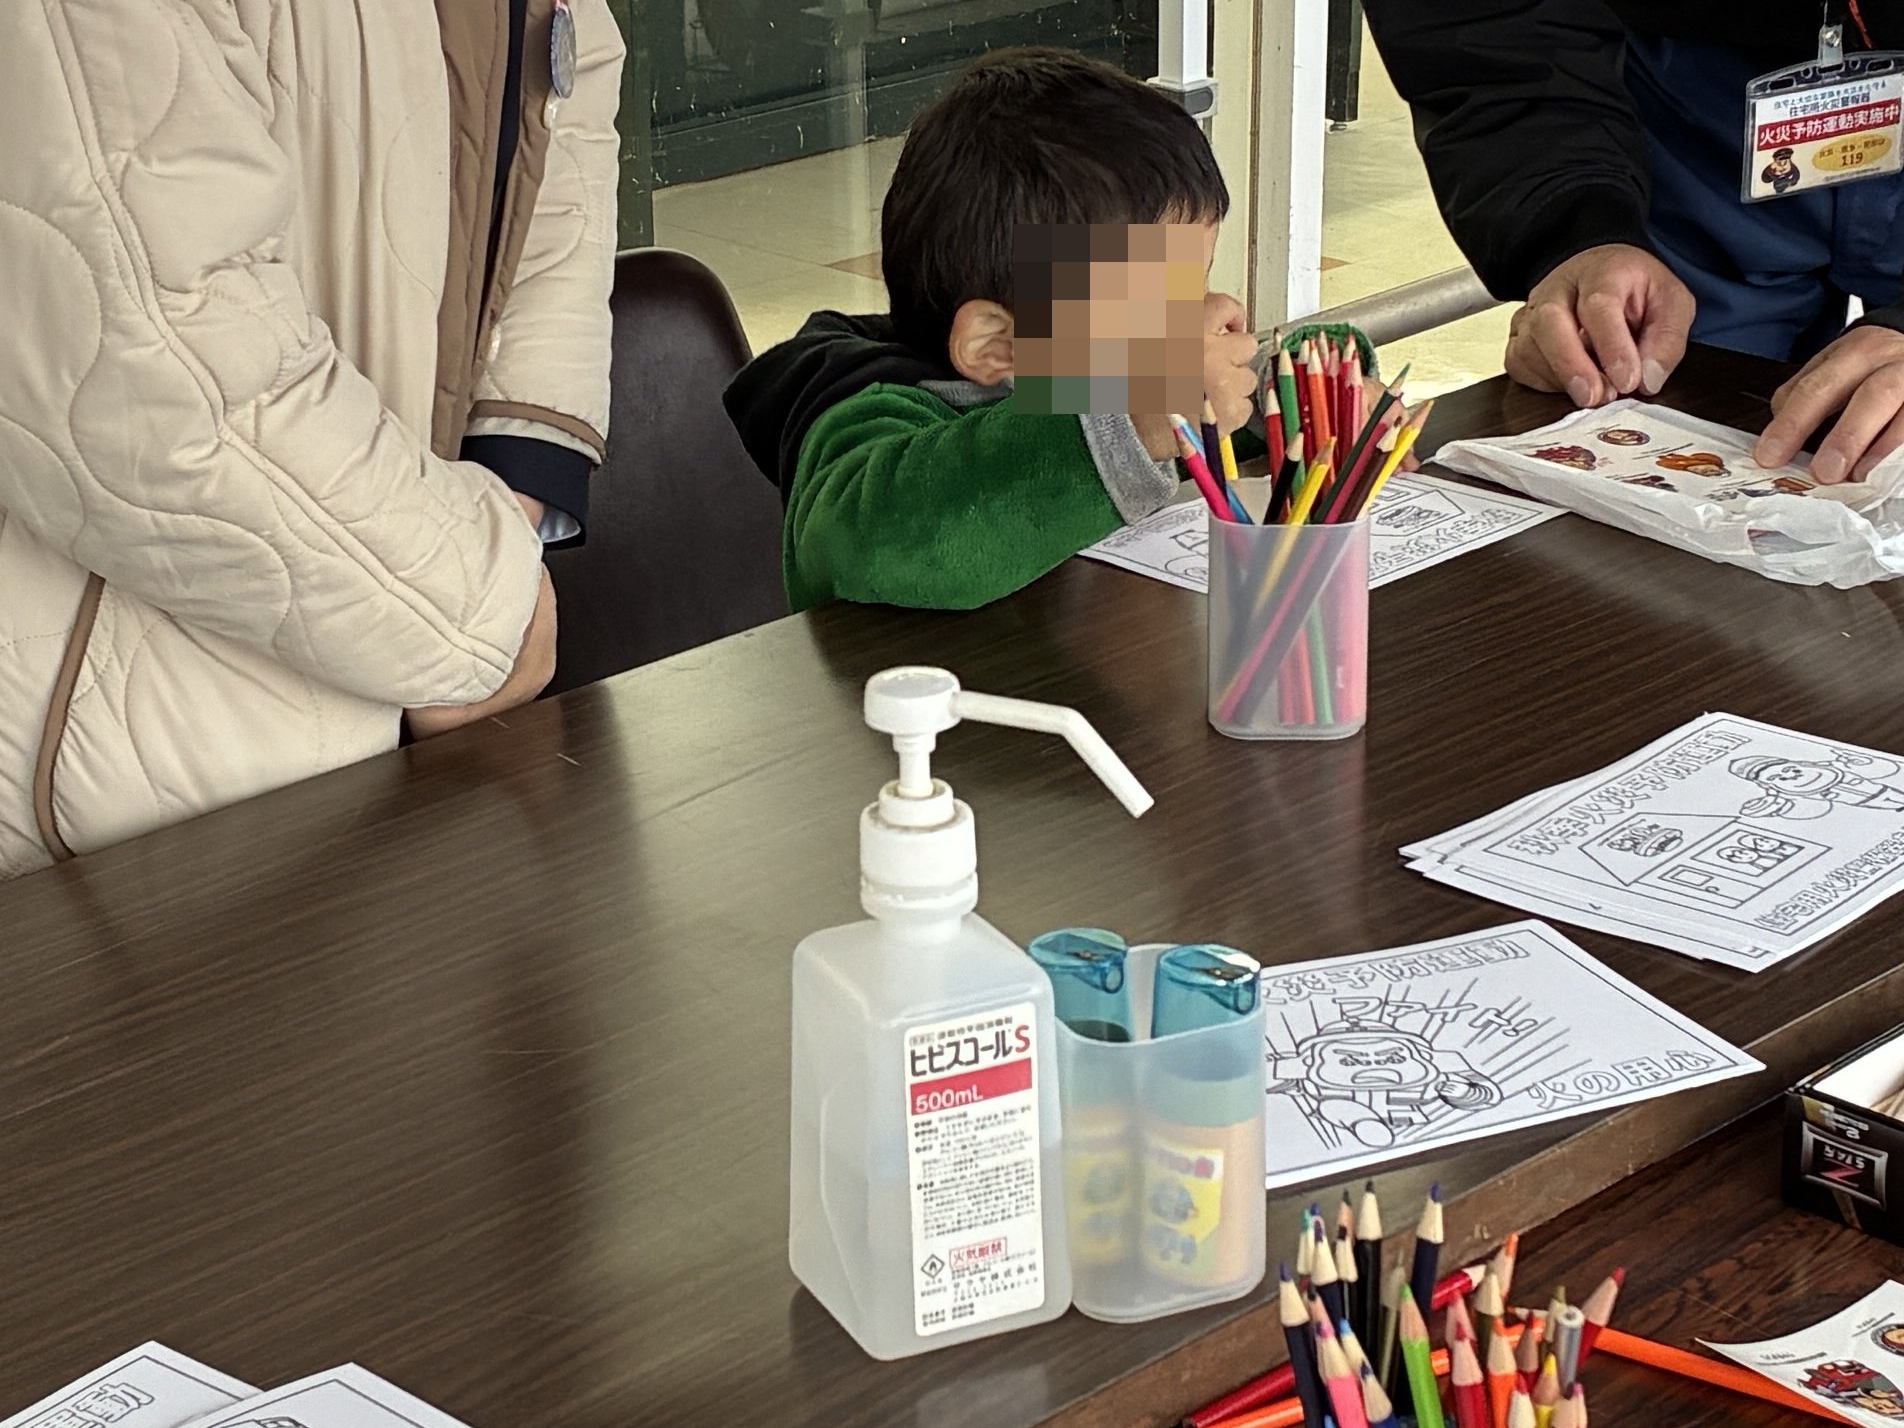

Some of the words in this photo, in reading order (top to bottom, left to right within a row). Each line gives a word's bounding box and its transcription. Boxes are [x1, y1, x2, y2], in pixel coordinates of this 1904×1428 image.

[1758, 103, 1900, 146] 火災予防運動実施中
[1840, 151, 1864, 168] 119
[1506, 729, 1752, 856] 秋季火災予防運動
[1527, 1049, 1716, 1110] 火の用心
[915, 1083, 984, 1114] 500mL
[953, 1240, 1004, 1266] 火気厳禁
